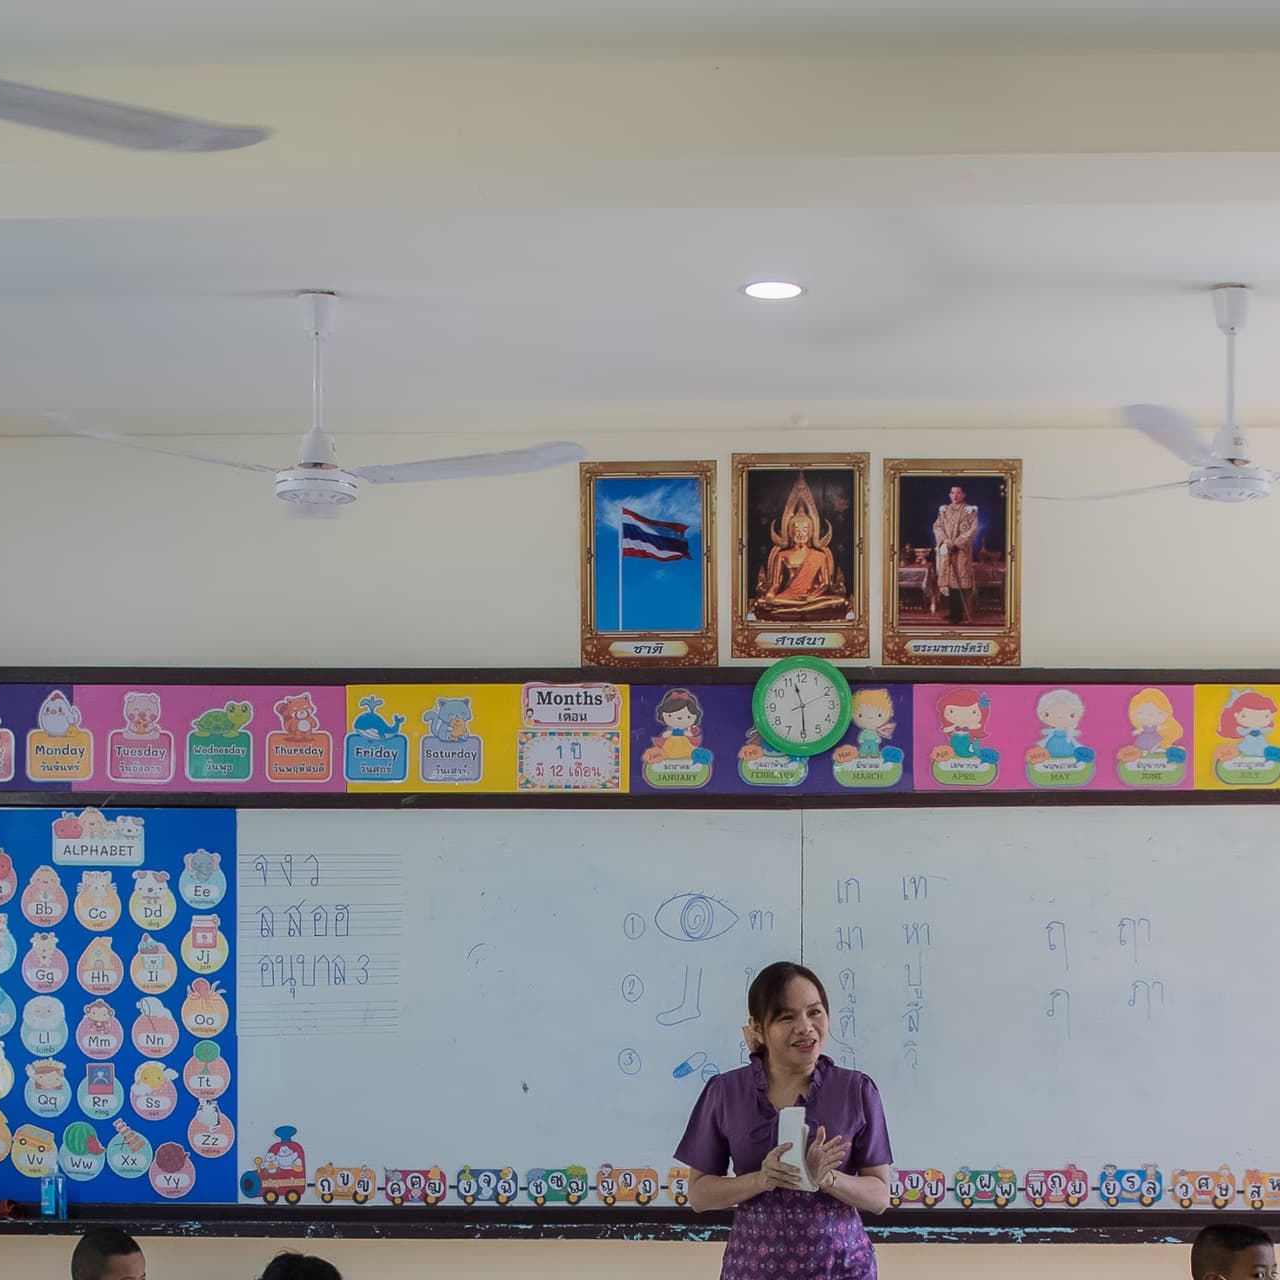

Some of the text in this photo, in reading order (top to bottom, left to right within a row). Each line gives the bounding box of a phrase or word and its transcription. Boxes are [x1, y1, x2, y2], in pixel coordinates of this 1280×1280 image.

[773, 634, 826, 646] ศาสนา
[633, 641, 664, 655] ชาติ
[784, 678, 793, 688] 11
[796, 673, 808, 683] 12
[536, 691, 604, 706] Months
[773, 688, 785, 699] 10
[558, 708, 588, 722] เดือน
[35, 744, 85, 759] Monday
[116, 746, 166, 760] Tuesday
[193, 745, 247, 757] Wednesday
[274, 746, 325, 760] Thursday
[355, 747, 399, 761] Friday
[425, 748, 478, 761] Saturday
[535, 761, 602, 778] มี 12 เดือน
[656, 773, 697, 783] JANUARY
[852, 772, 883, 781] MARCH
[952, 772, 977, 781] APRIL
[63, 845, 135, 857] ALPHABET
[304, 854, 319, 886] ว
[193, 885, 211, 898] Ee
[837, 877, 861, 903] เก
[35, 903, 53, 915] Bb
[88, 908, 107, 920] Cc
[144, 906, 162, 919] Dd
[256, 906, 274, 937] ล
[284, 899, 306, 937] ส
[311, 905, 328, 937] อ
[749, 910, 774, 931] ตา
[836, 922, 930, 951] มา หา
[196, 950, 211, 966] Jj
[35, 970, 55, 984] Gg
[91, 971, 110, 983] Hh
[148, 970, 159, 982] Ii
[258, 954, 370, 999] อนุบาล 3
[194, 1014, 215, 1026] Oo
[39, 1031, 50, 1044] Ll
[88, 1036, 111, 1047] Mm
[146, 1035, 164, 1046] Nn
[198, 1077, 211, 1088] Tt
[37, 1094, 57, 1107] Qq
[93, 1097, 109, 1109] Rr
[145, 1098, 161, 1109] Ss
[201, 1134, 219, 1146] Zz
[26, 1154, 44, 1165] Vv
[70, 1158, 93, 1170] Ww
[121, 1155, 137, 1166] Xx
[164, 1176, 180, 1189] Yy
[320, 1178, 331, 1192] ก
[340, 1172, 349, 1186] ข
[908, 1176, 919, 1188] บ
[1125, 1176, 1135, 1189] ร
[390, 1183, 402, 1195] ค
[927, 1181, 940, 1196] ป
[1071, 1183, 1082, 1195] ม
